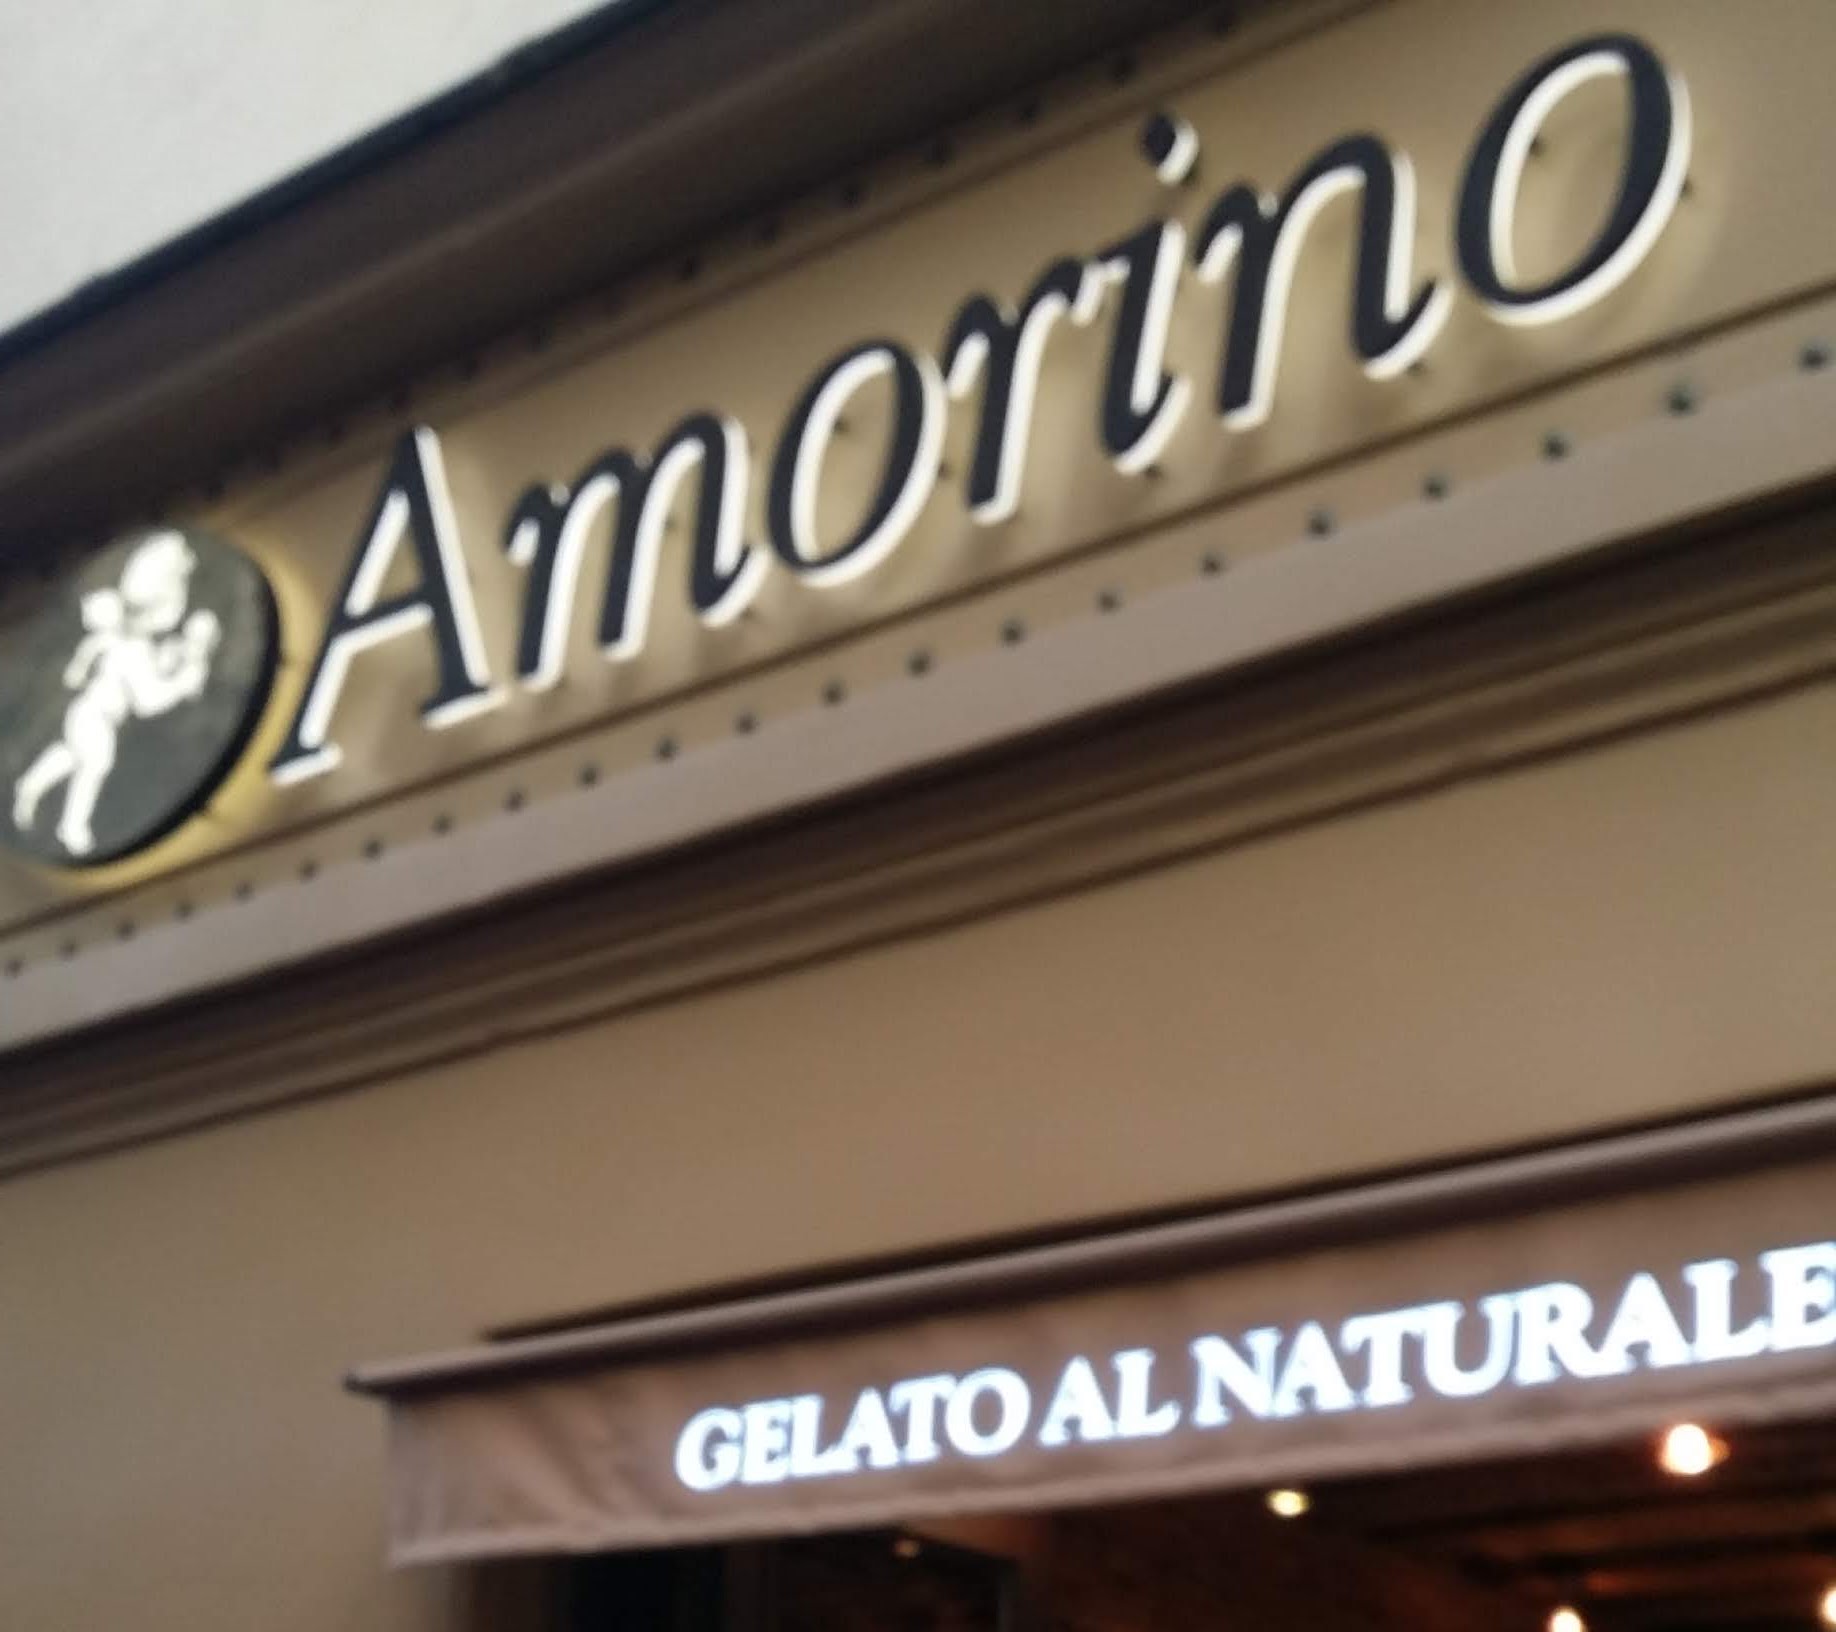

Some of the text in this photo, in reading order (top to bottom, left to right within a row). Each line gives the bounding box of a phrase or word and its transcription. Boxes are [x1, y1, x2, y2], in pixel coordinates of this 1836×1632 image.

[266, 32, 1694, 784] Amorino
[676, 1240, 1836, 1491] GELATO AL NATURALE
